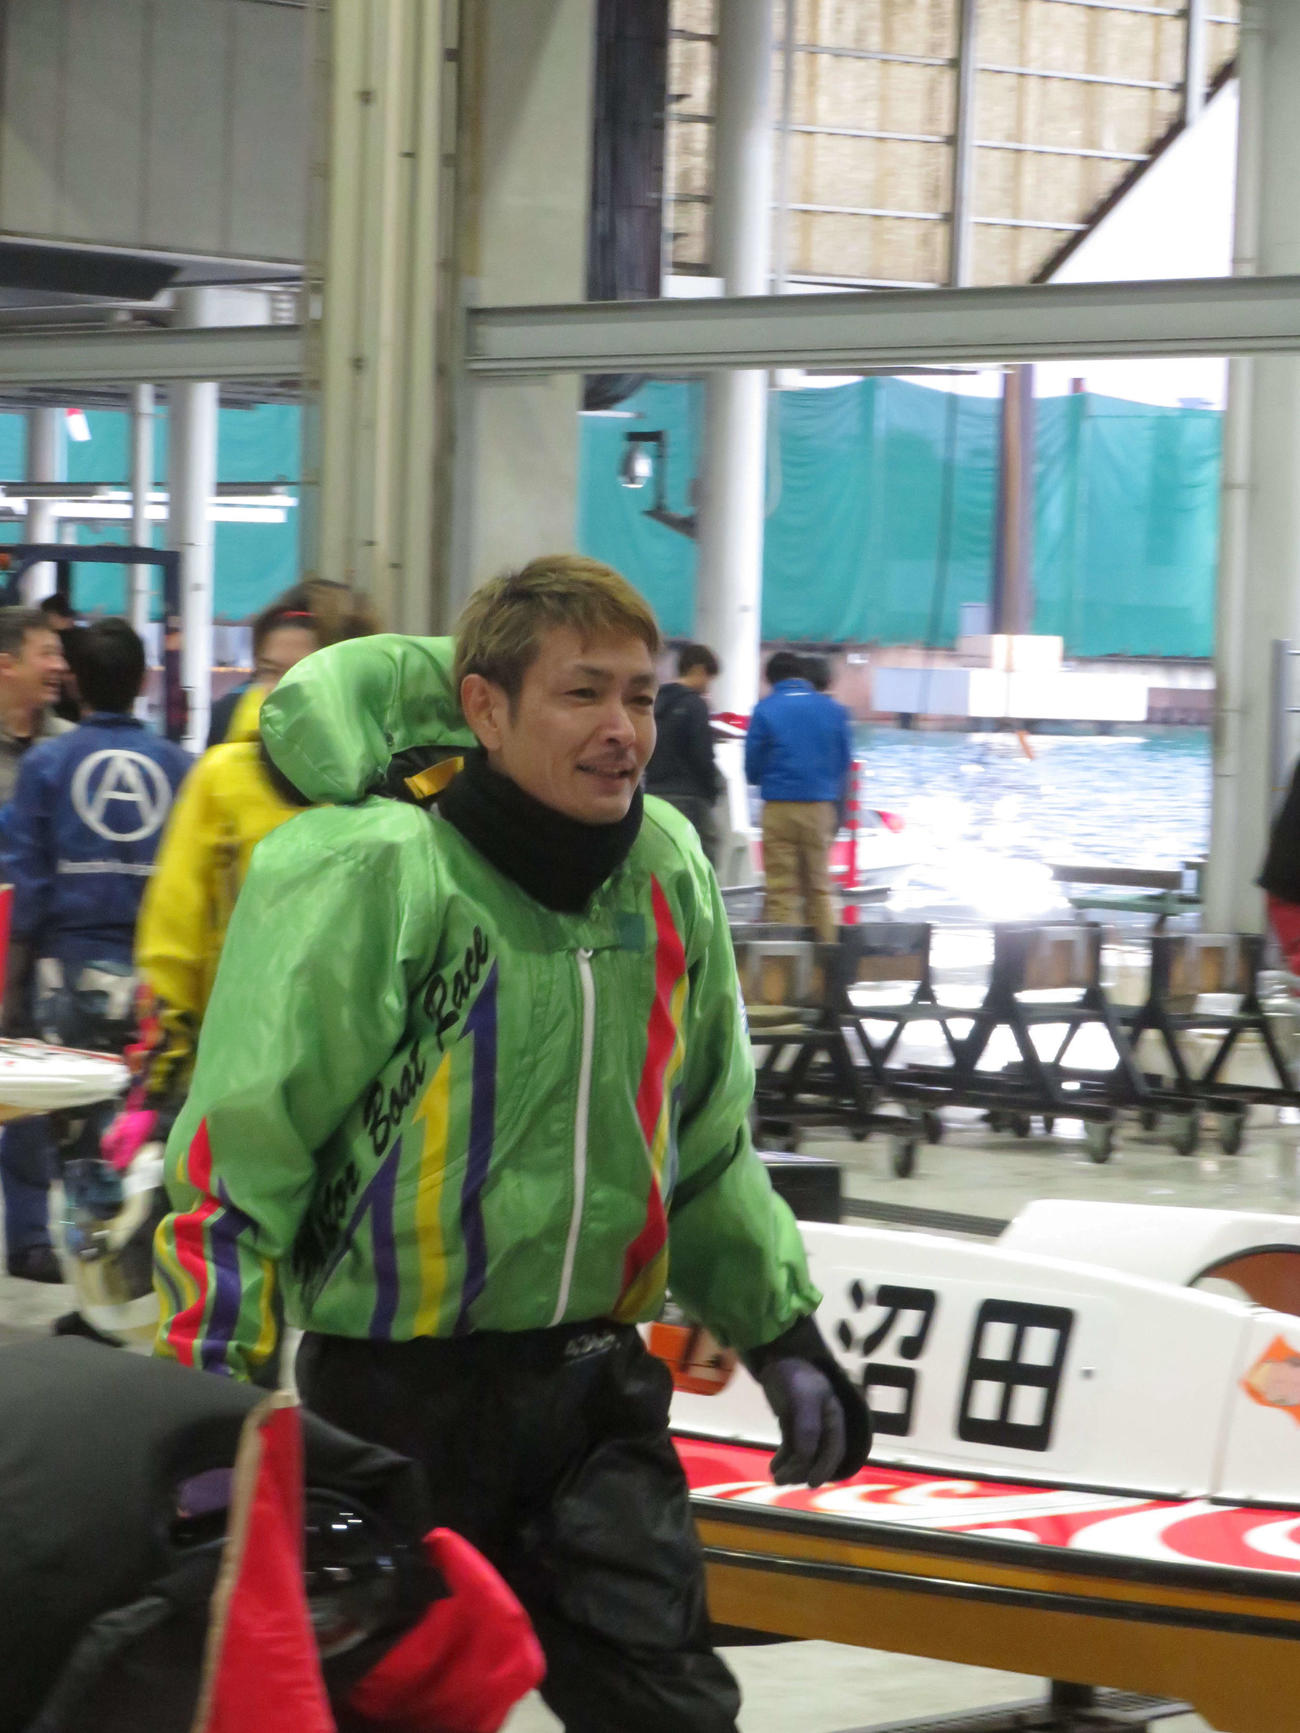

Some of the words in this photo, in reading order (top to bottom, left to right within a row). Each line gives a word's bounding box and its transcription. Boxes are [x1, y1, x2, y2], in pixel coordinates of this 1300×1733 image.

[363, 1040, 426, 1157] Boat
[423, 925, 489, 1052] Race
[836, 1279, 1075, 1452] 沼田
